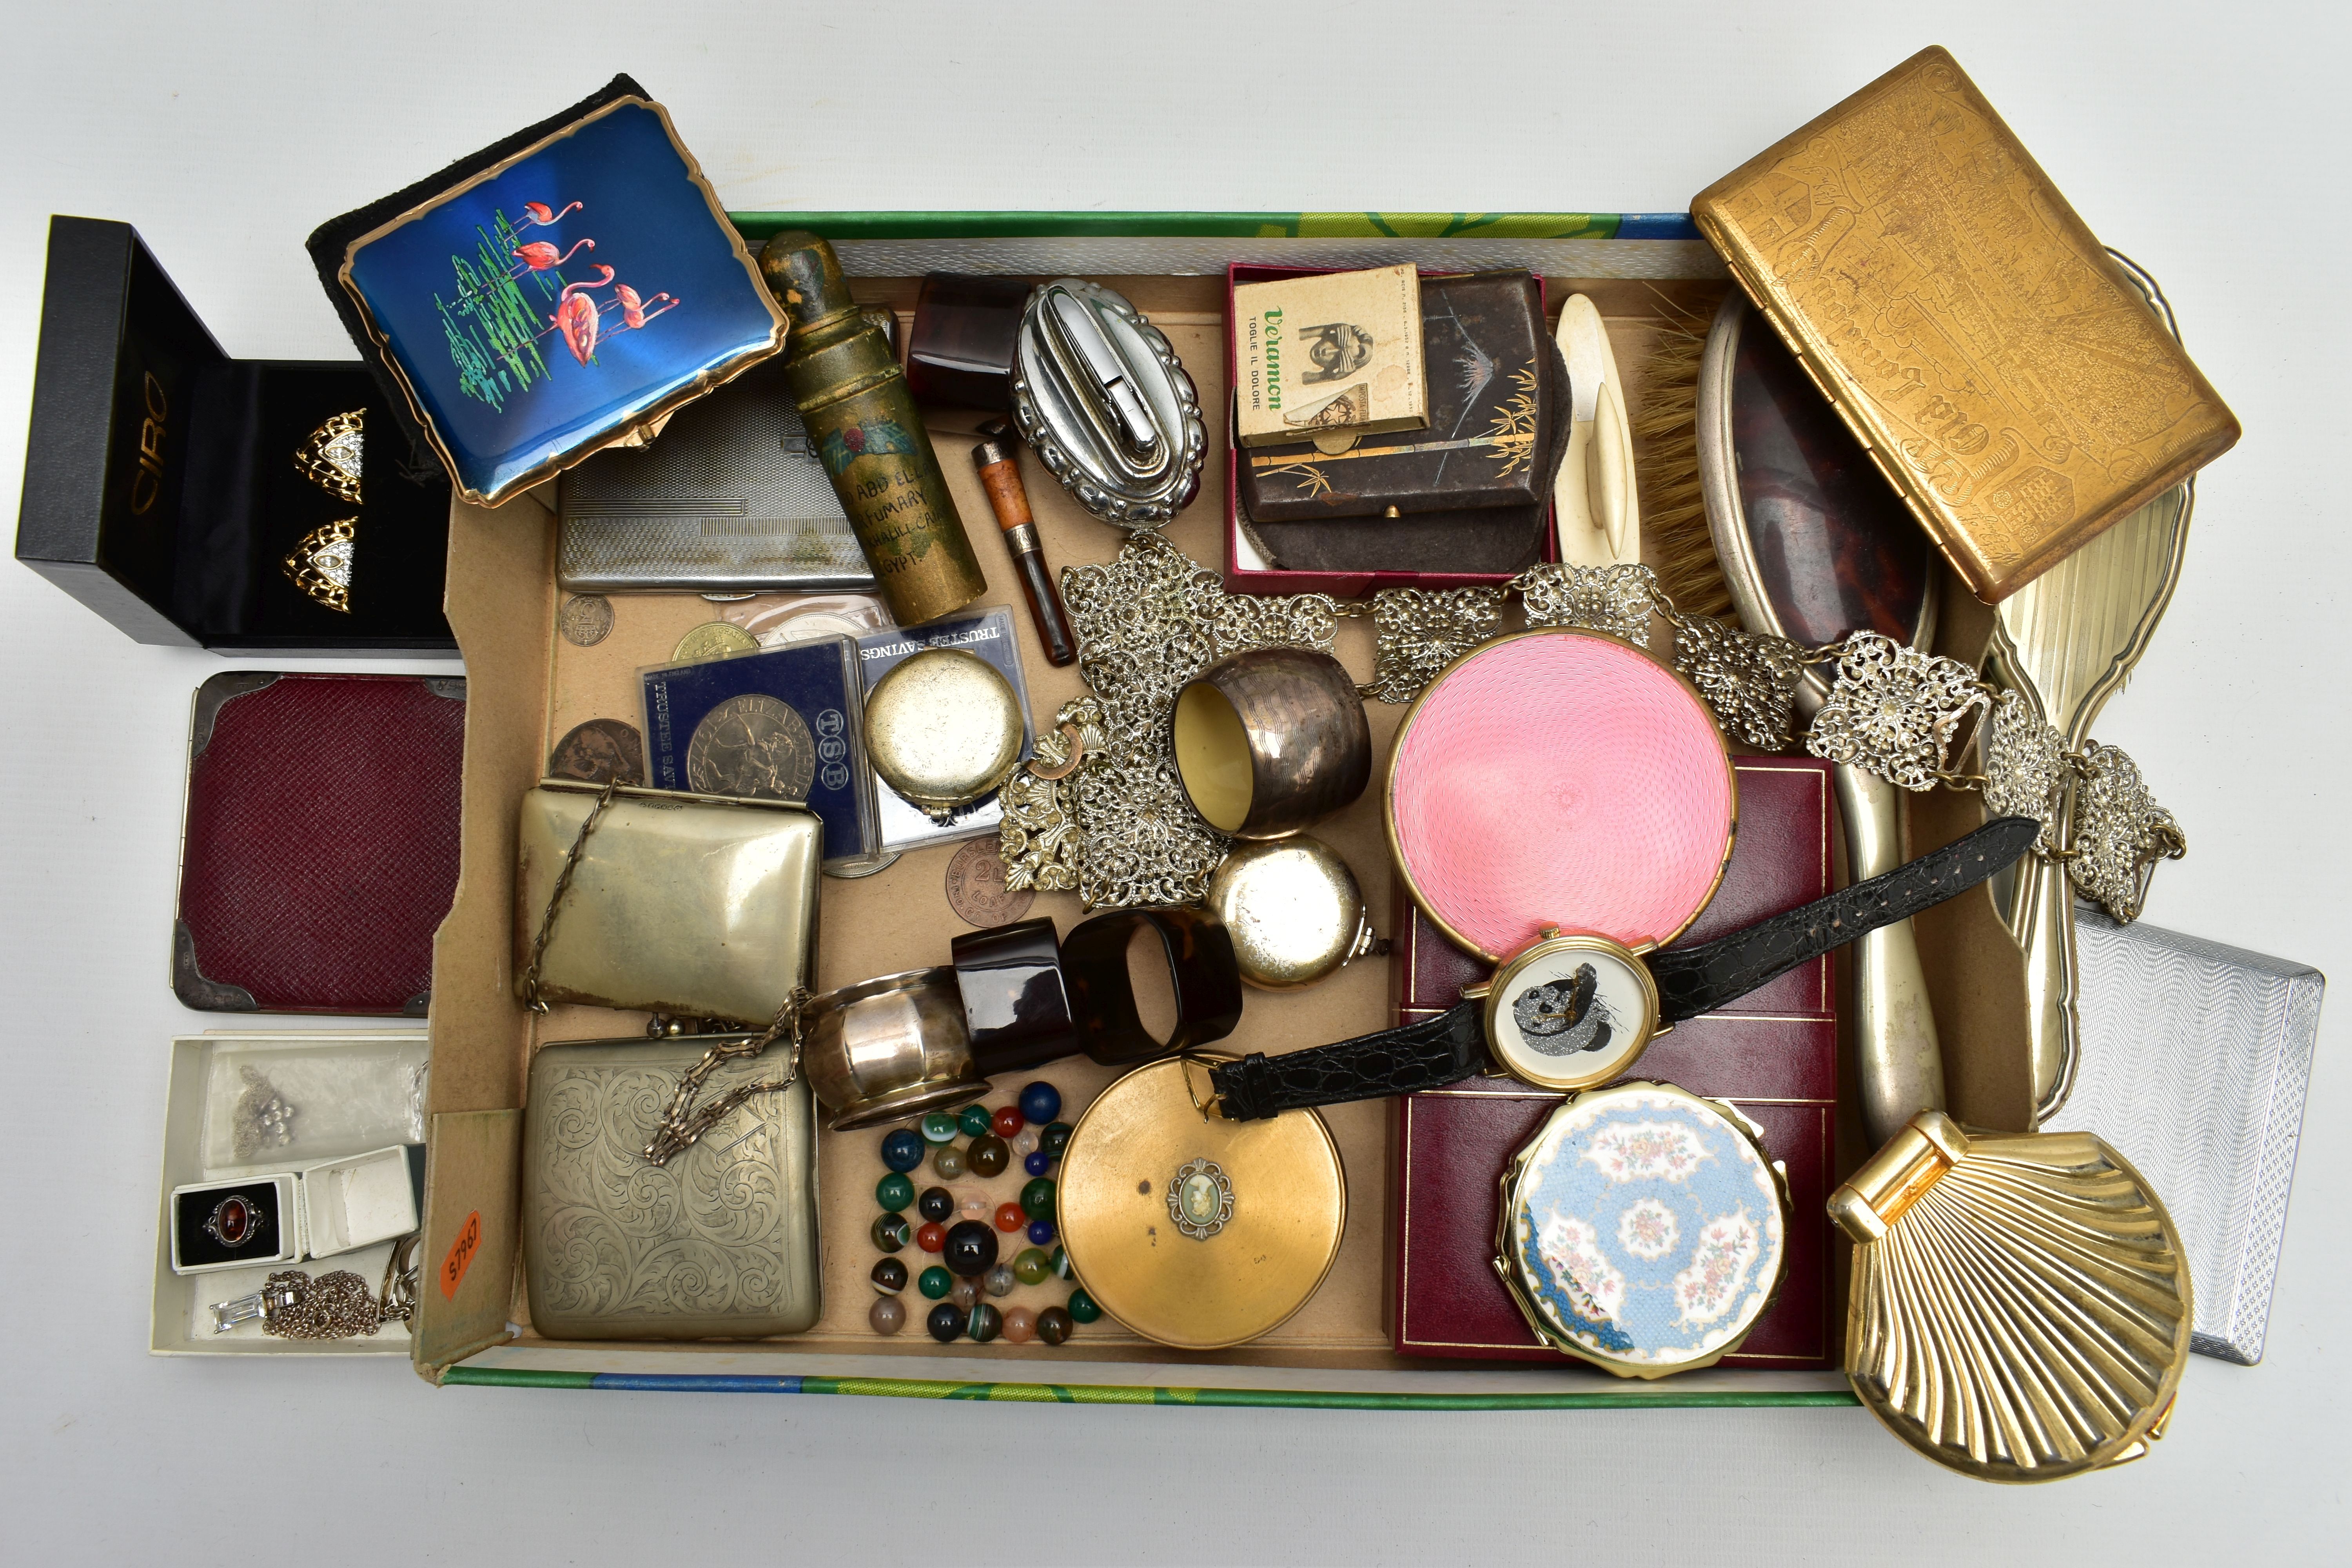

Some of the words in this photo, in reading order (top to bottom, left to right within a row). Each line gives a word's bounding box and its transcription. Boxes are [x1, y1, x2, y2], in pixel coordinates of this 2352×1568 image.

[1249, 317, 1258, 351] TOGLIE
[1811, 274, 1925, 404] London
[1251, 356, 1258, 365] IL
[1264, 306, 1283, 412] Veramon
[1251, 370, 1260, 411] DOLORE
[131, 371, 166, 515] CIRO
[1914, 393, 1989, 458] Old
[857, 477, 889, 501] ABD
[860, 639, 925, 661] SAVINGS
[930, 627, 1000, 648] TRUSTEE
[655, 682, 671, 752] TRUSTEE
[690, 718, 717, 766] 1977
[819, 711, 846, 788] TSB
[971, 891, 1005, 907] LOAF
